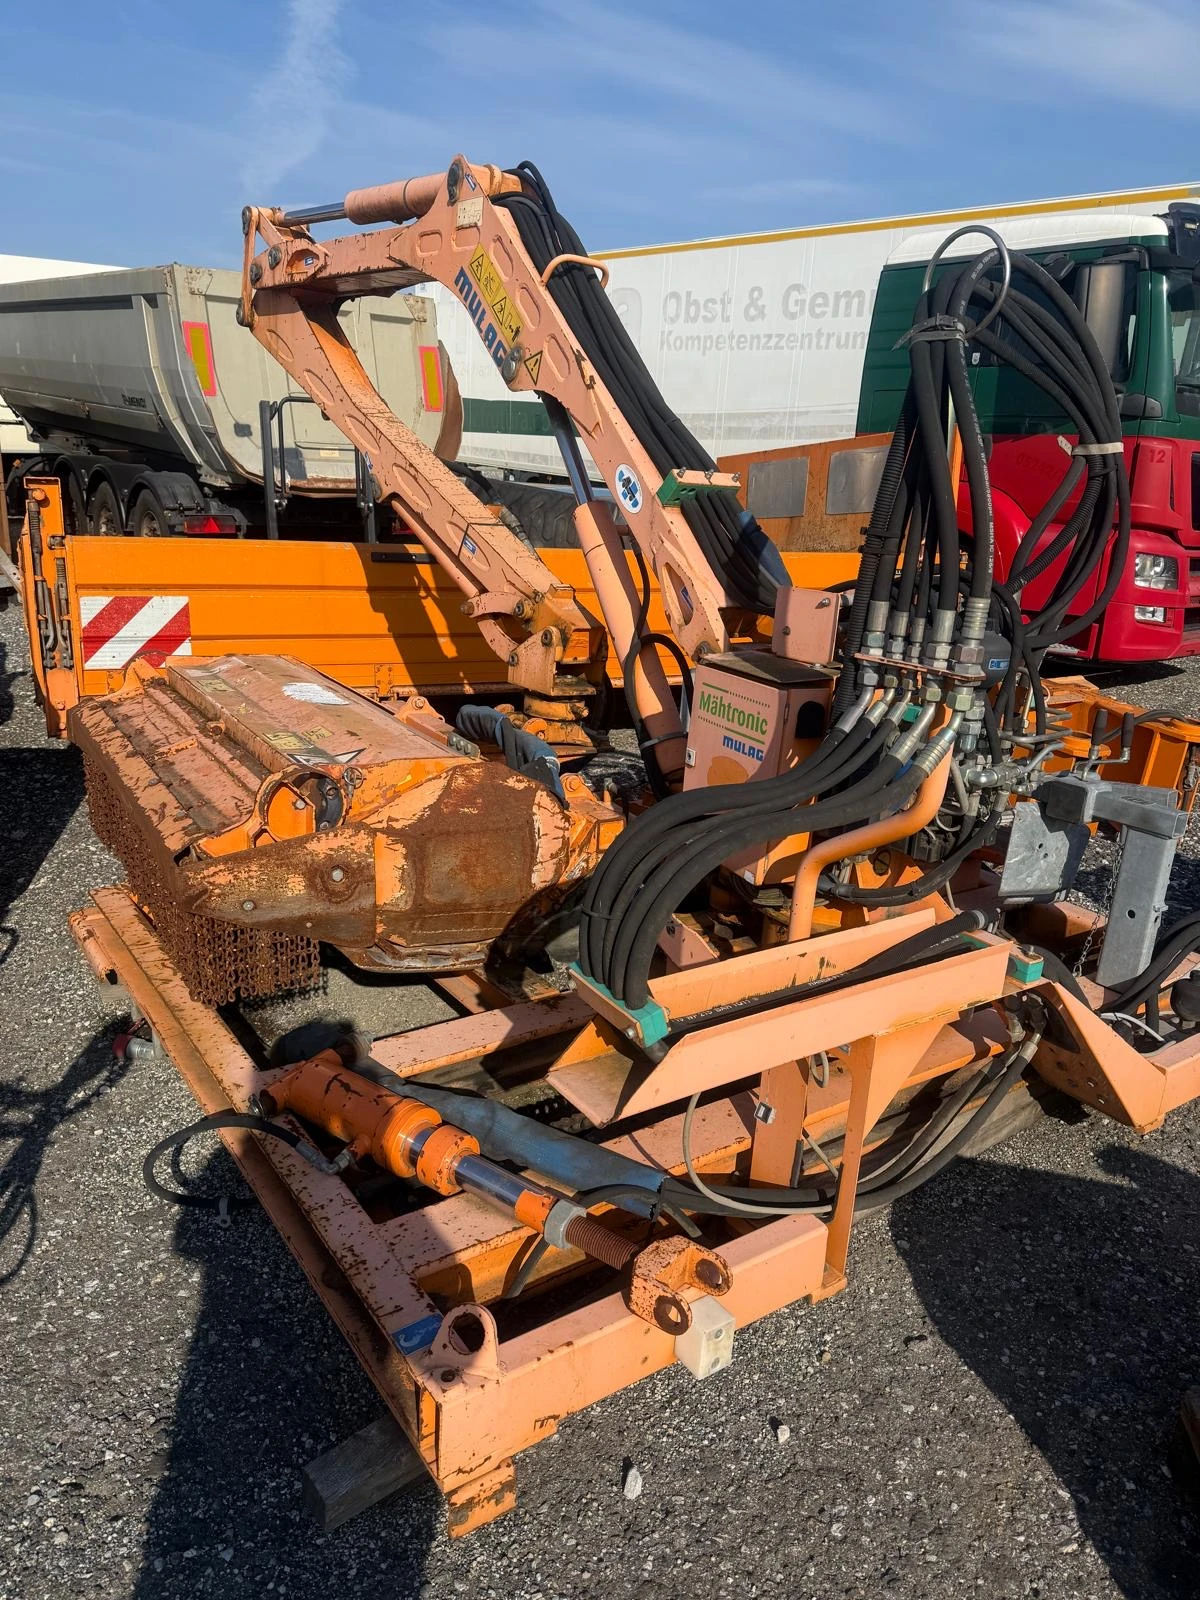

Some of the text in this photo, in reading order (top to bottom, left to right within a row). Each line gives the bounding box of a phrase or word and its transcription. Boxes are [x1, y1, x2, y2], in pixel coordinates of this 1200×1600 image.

[662, 283, 876, 325] Obst & Gem
[1149, 449, 1166, 464] 12
[700, 691, 768, 735] Mähtronic
[722, 735, 764, 761] MULAG
